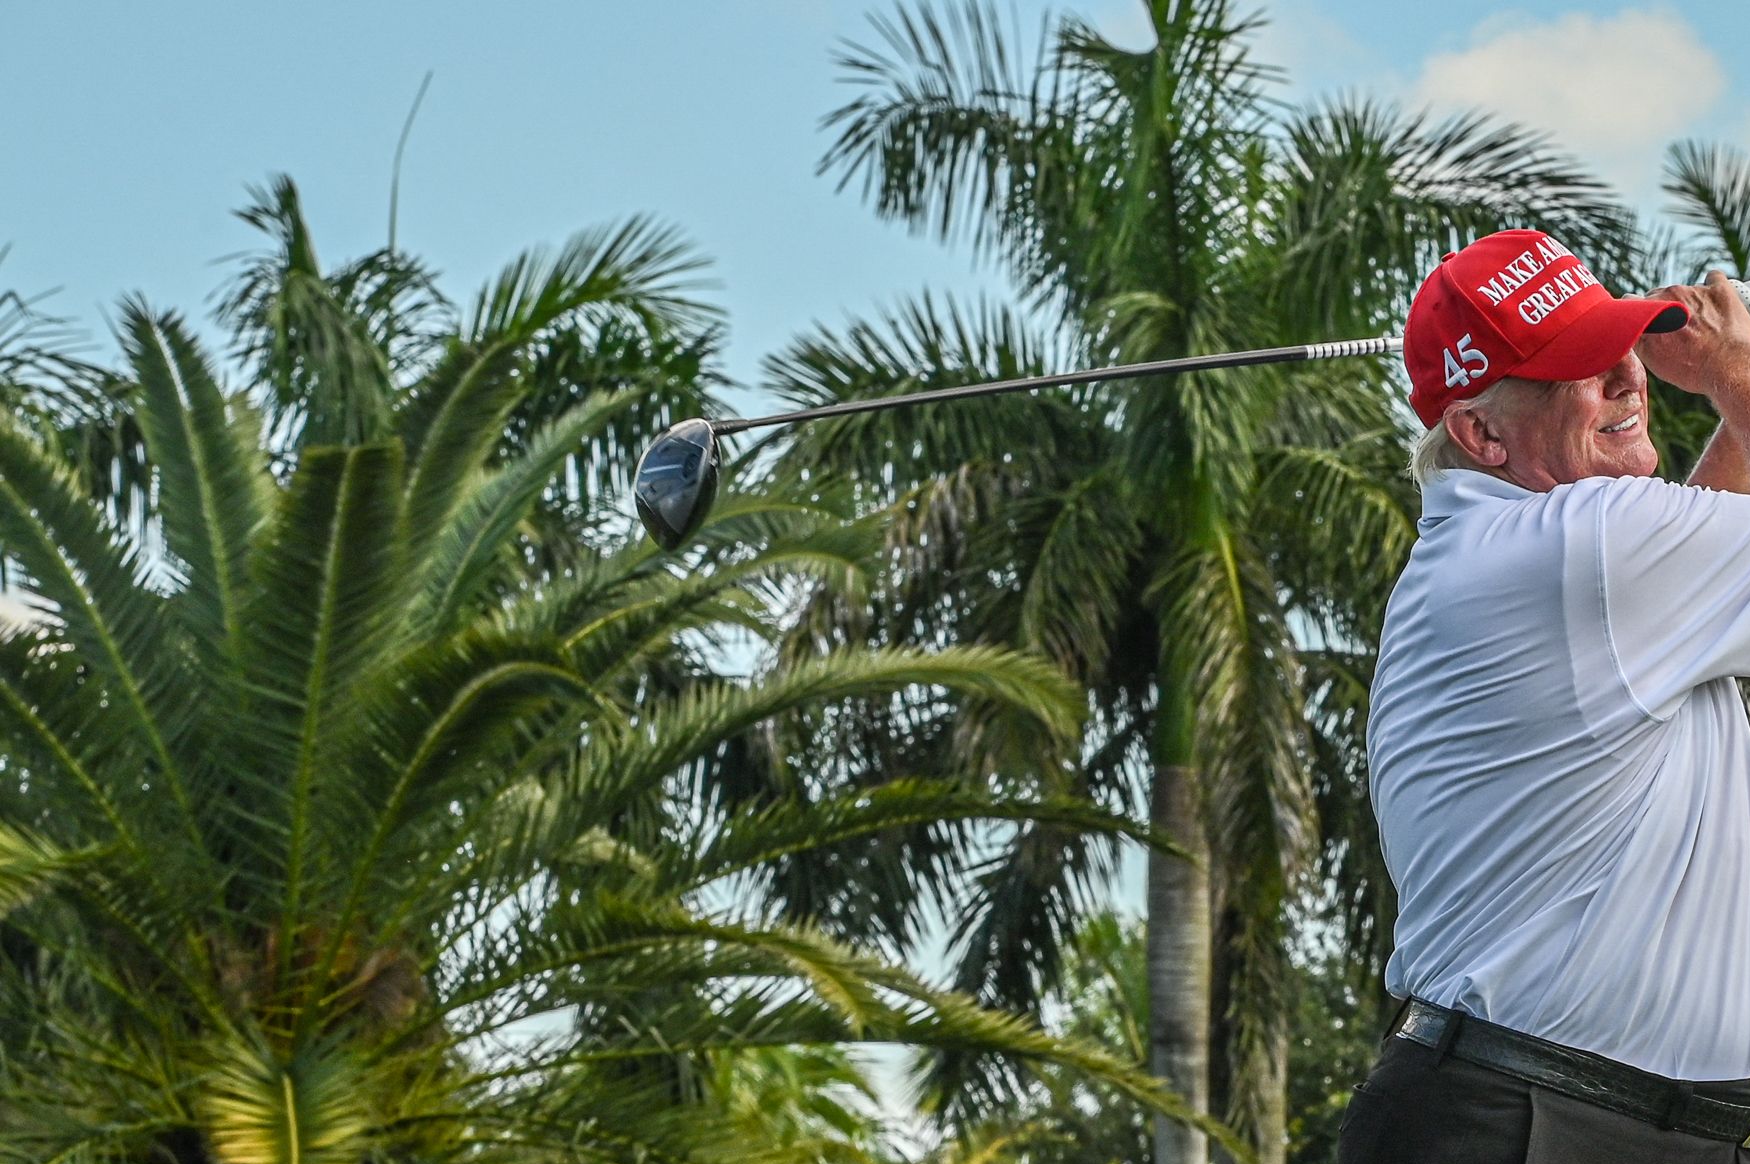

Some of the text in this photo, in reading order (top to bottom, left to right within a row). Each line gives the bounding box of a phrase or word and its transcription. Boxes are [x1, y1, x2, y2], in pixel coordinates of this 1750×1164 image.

[1477, 235, 1576, 306] MAKE AM
[1518, 269, 1582, 324] GREAT
[1443, 333, 1489, 388] 45
